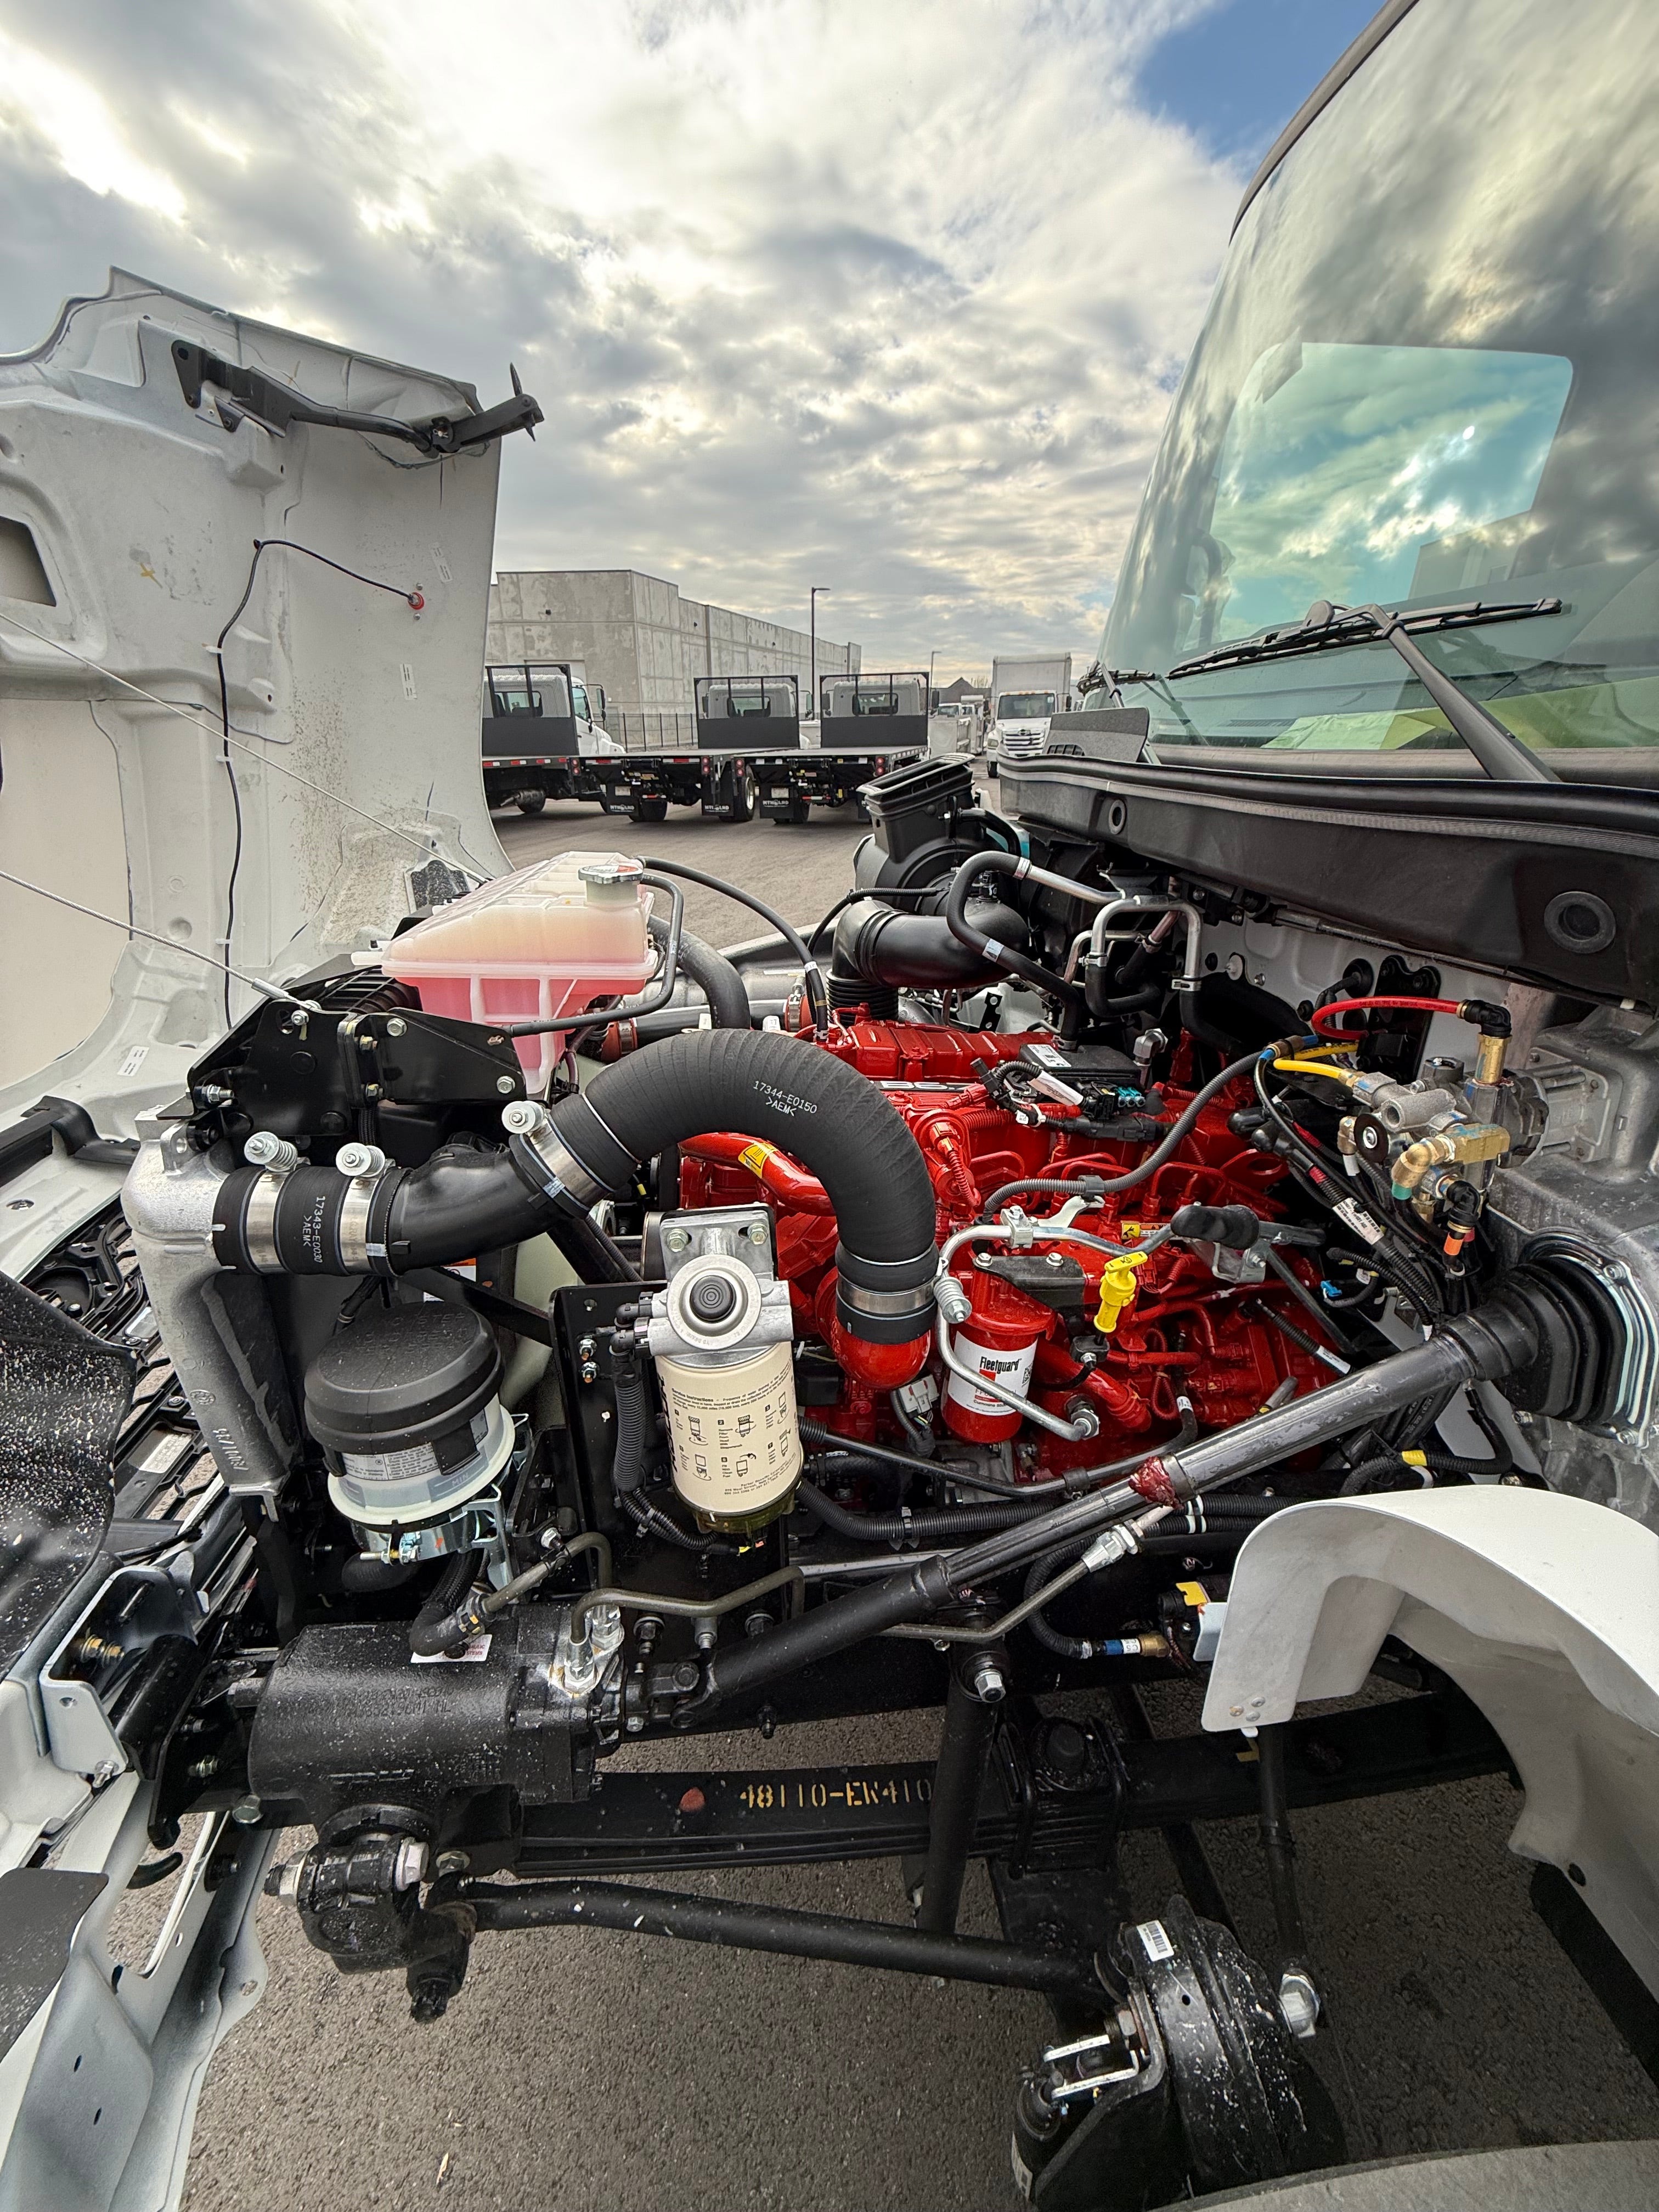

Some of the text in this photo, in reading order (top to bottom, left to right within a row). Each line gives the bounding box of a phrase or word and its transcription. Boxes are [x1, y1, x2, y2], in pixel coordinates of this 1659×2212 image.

[753, 1081, 817, 1114] 17344-E0150
[312, 1196, 326, 1263] 17343-E0030
[979, 1356, 1020, 1374] Fleetguard
[452, 1472, 469, 1486] MIN
